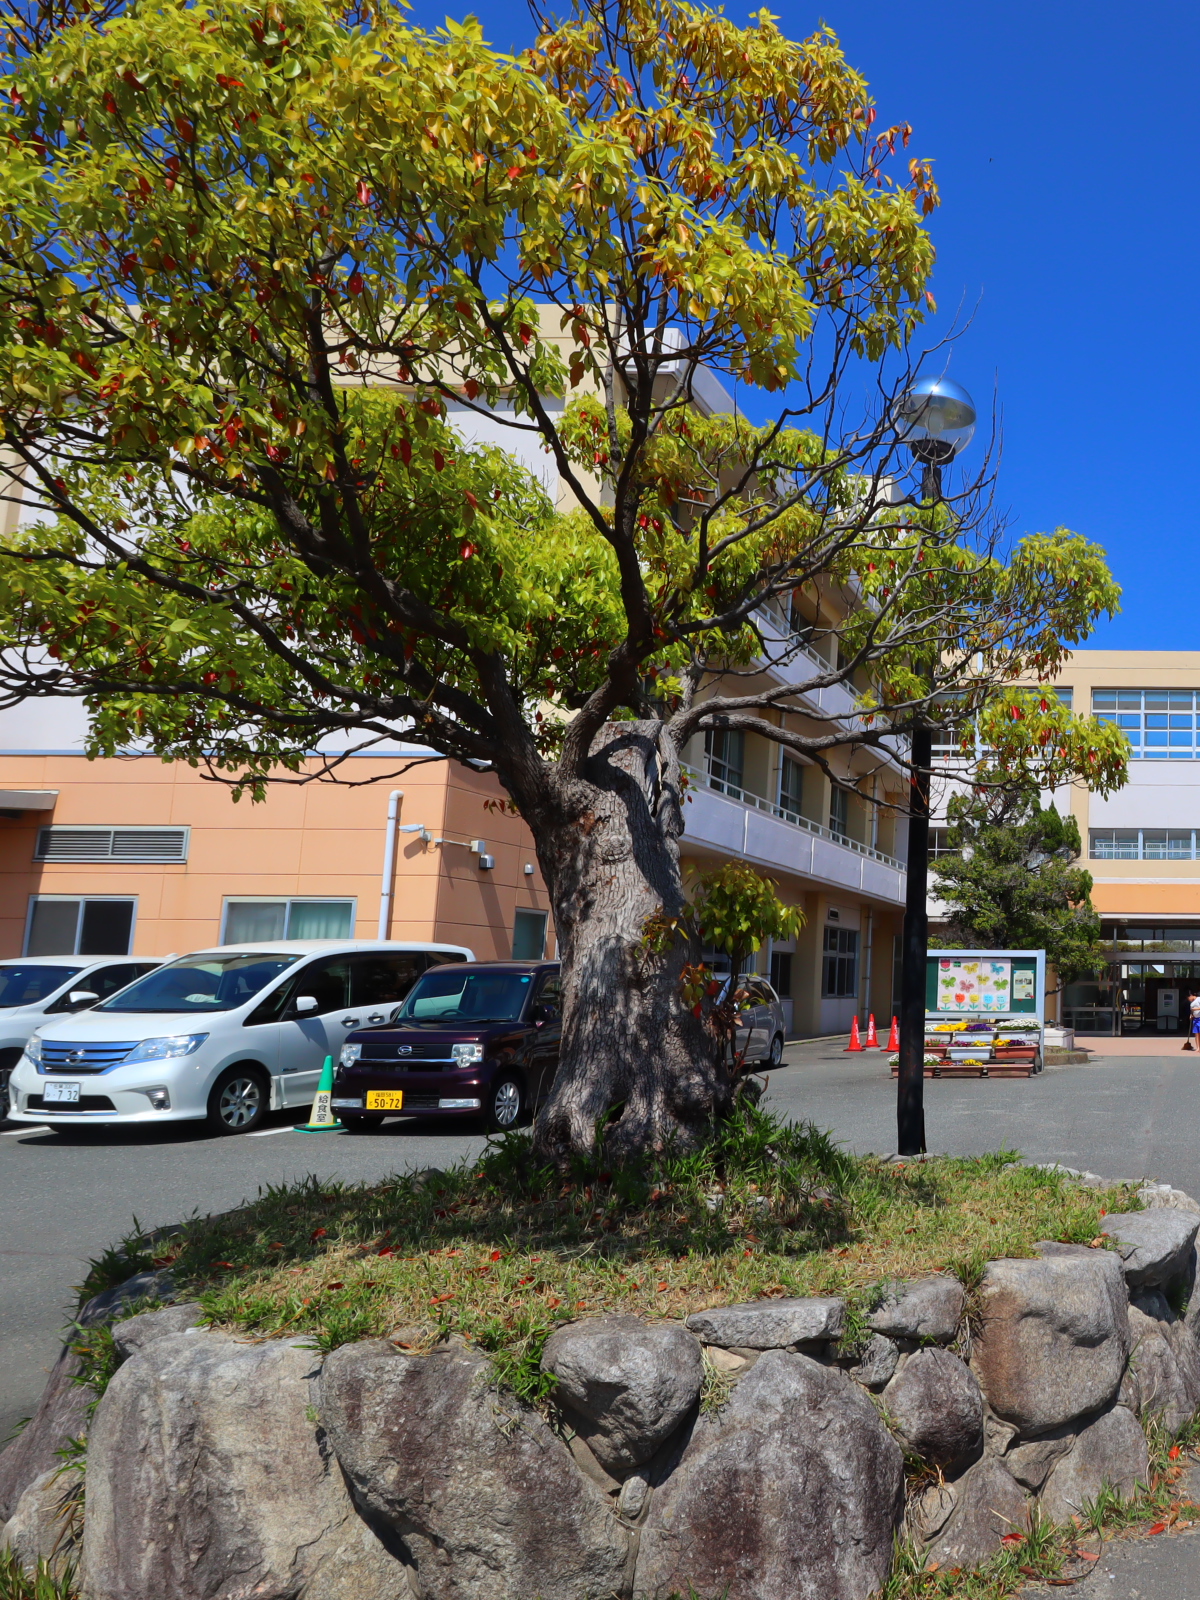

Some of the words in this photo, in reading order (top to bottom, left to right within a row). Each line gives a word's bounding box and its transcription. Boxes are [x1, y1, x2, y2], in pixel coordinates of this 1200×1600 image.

[316, 1095, 328, 1122] 給食室
[374, 1098, 400, 1108] 50-72
